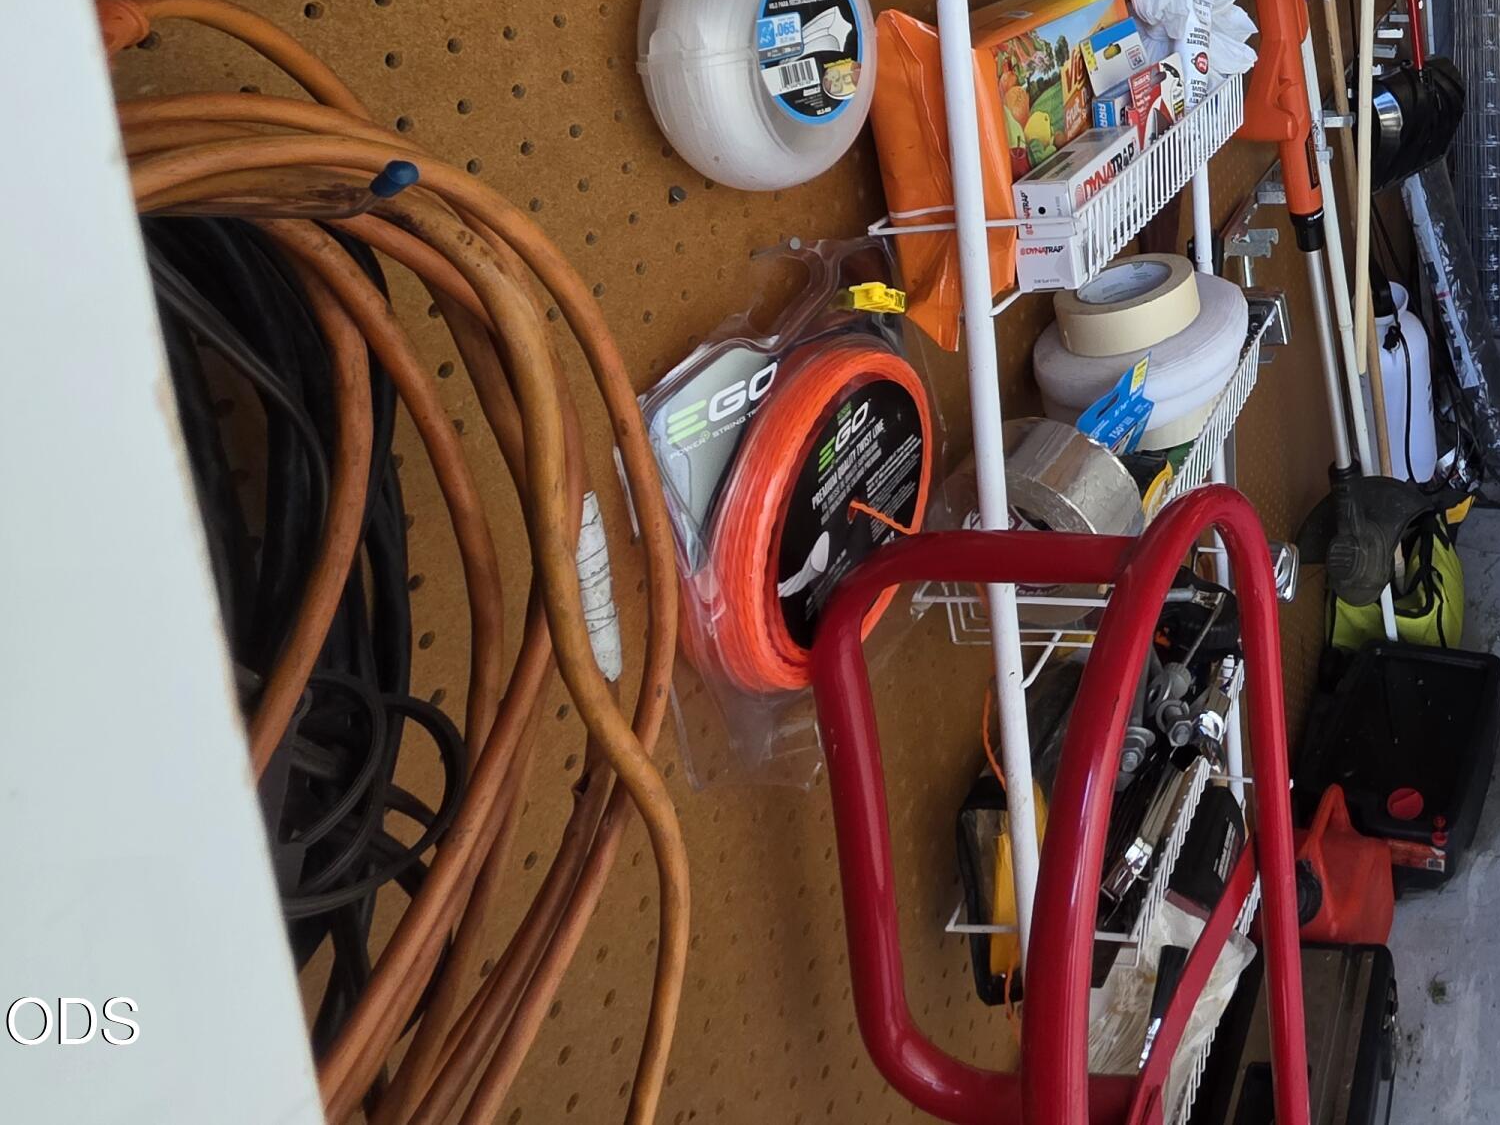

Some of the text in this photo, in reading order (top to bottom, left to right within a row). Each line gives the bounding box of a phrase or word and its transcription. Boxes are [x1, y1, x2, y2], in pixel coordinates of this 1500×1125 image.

[1097, 102, 1108, 128] ARR
[1083, 141, 1136, 202] DYNATRAP
[1026, 246, 1063, 256] DYNATRAP
[666, 361, 778, 446] EGO
[712, 417, 747, 438] STRING
[818, 401, 869, 473] EGO
